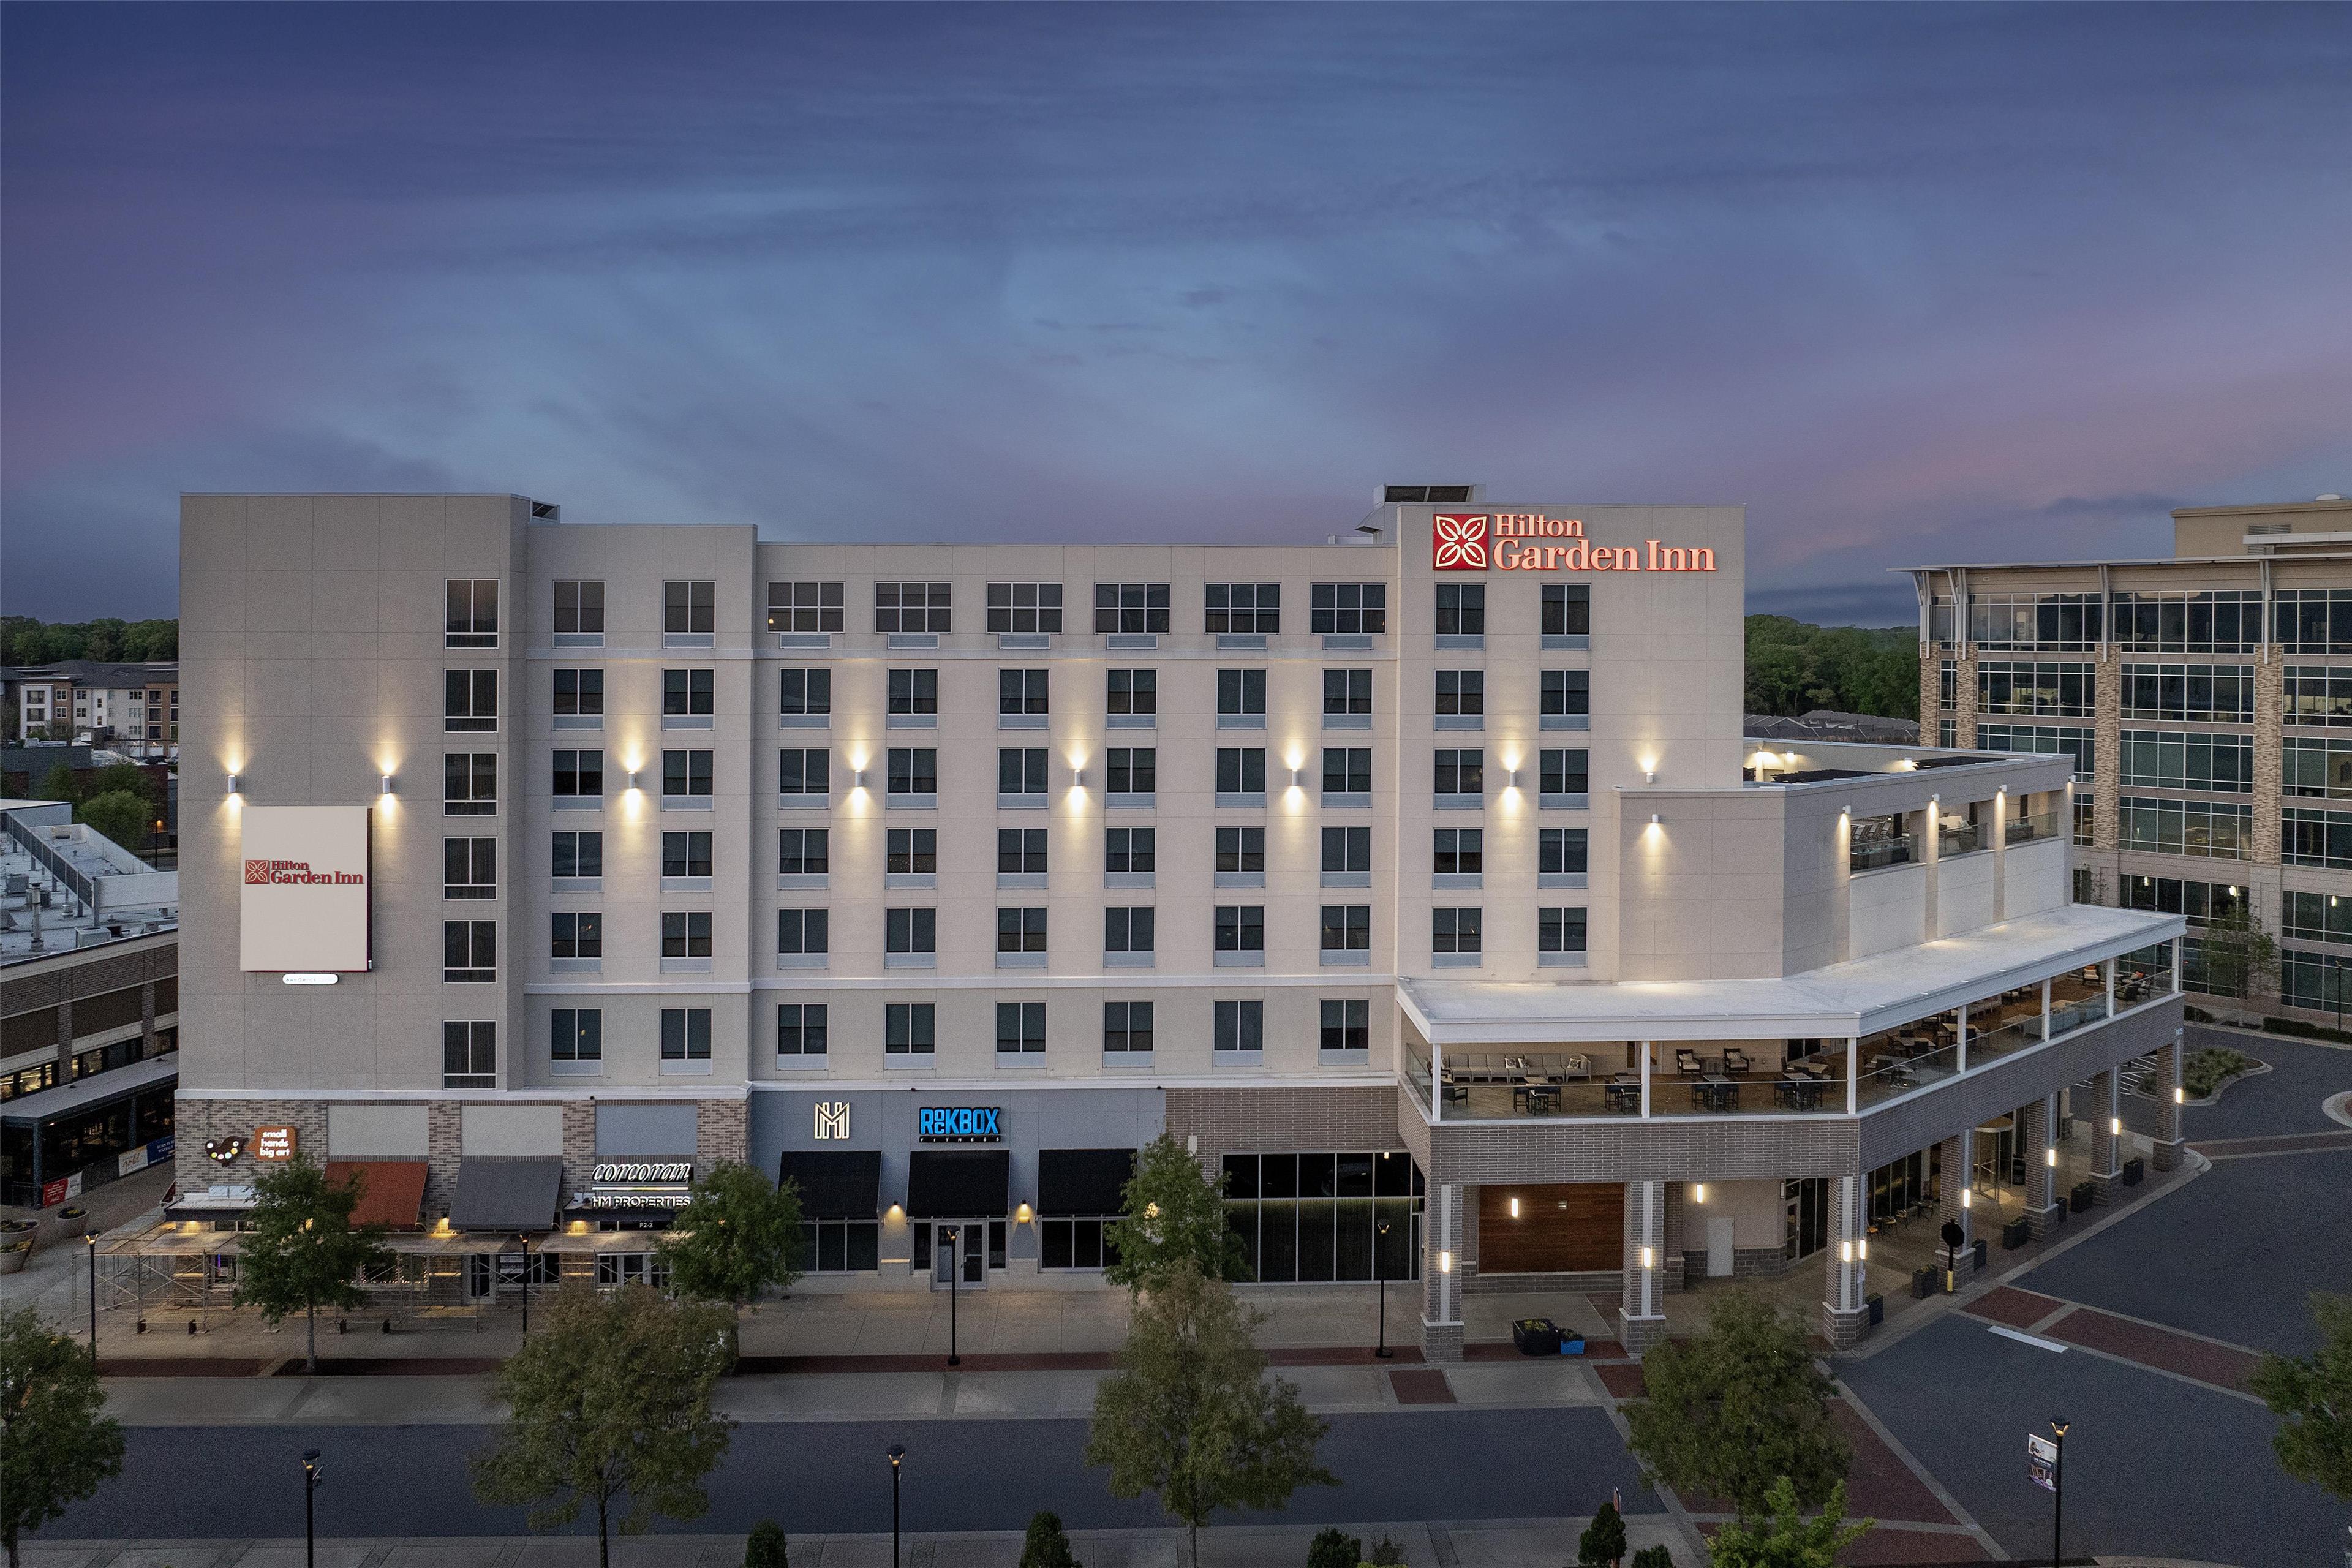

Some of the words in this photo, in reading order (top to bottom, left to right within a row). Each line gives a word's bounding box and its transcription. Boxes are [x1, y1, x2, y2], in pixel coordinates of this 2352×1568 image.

[1494, 514, 1585, 537] Hilton
[1493, 539, 1641, 571] Garden
[1645, 540, 1717, 571] Inn
[271, 860, 309, 870] Hilton
[270, 870, 333, 884] Garden
[334, 871, 364, 884] Inn
[921, 1109, 999, 1134] ROCKBOX
[262, 1129, 287, 1138] small
[260, 1138, 289, 1147] hands
[260, 1147, 274, 1158] big
[592, 1163, 691, 1182] corcoran
[592, 1196, 611, 1207] HM
[614, 1196, 691, 1208] PROPERTIES
